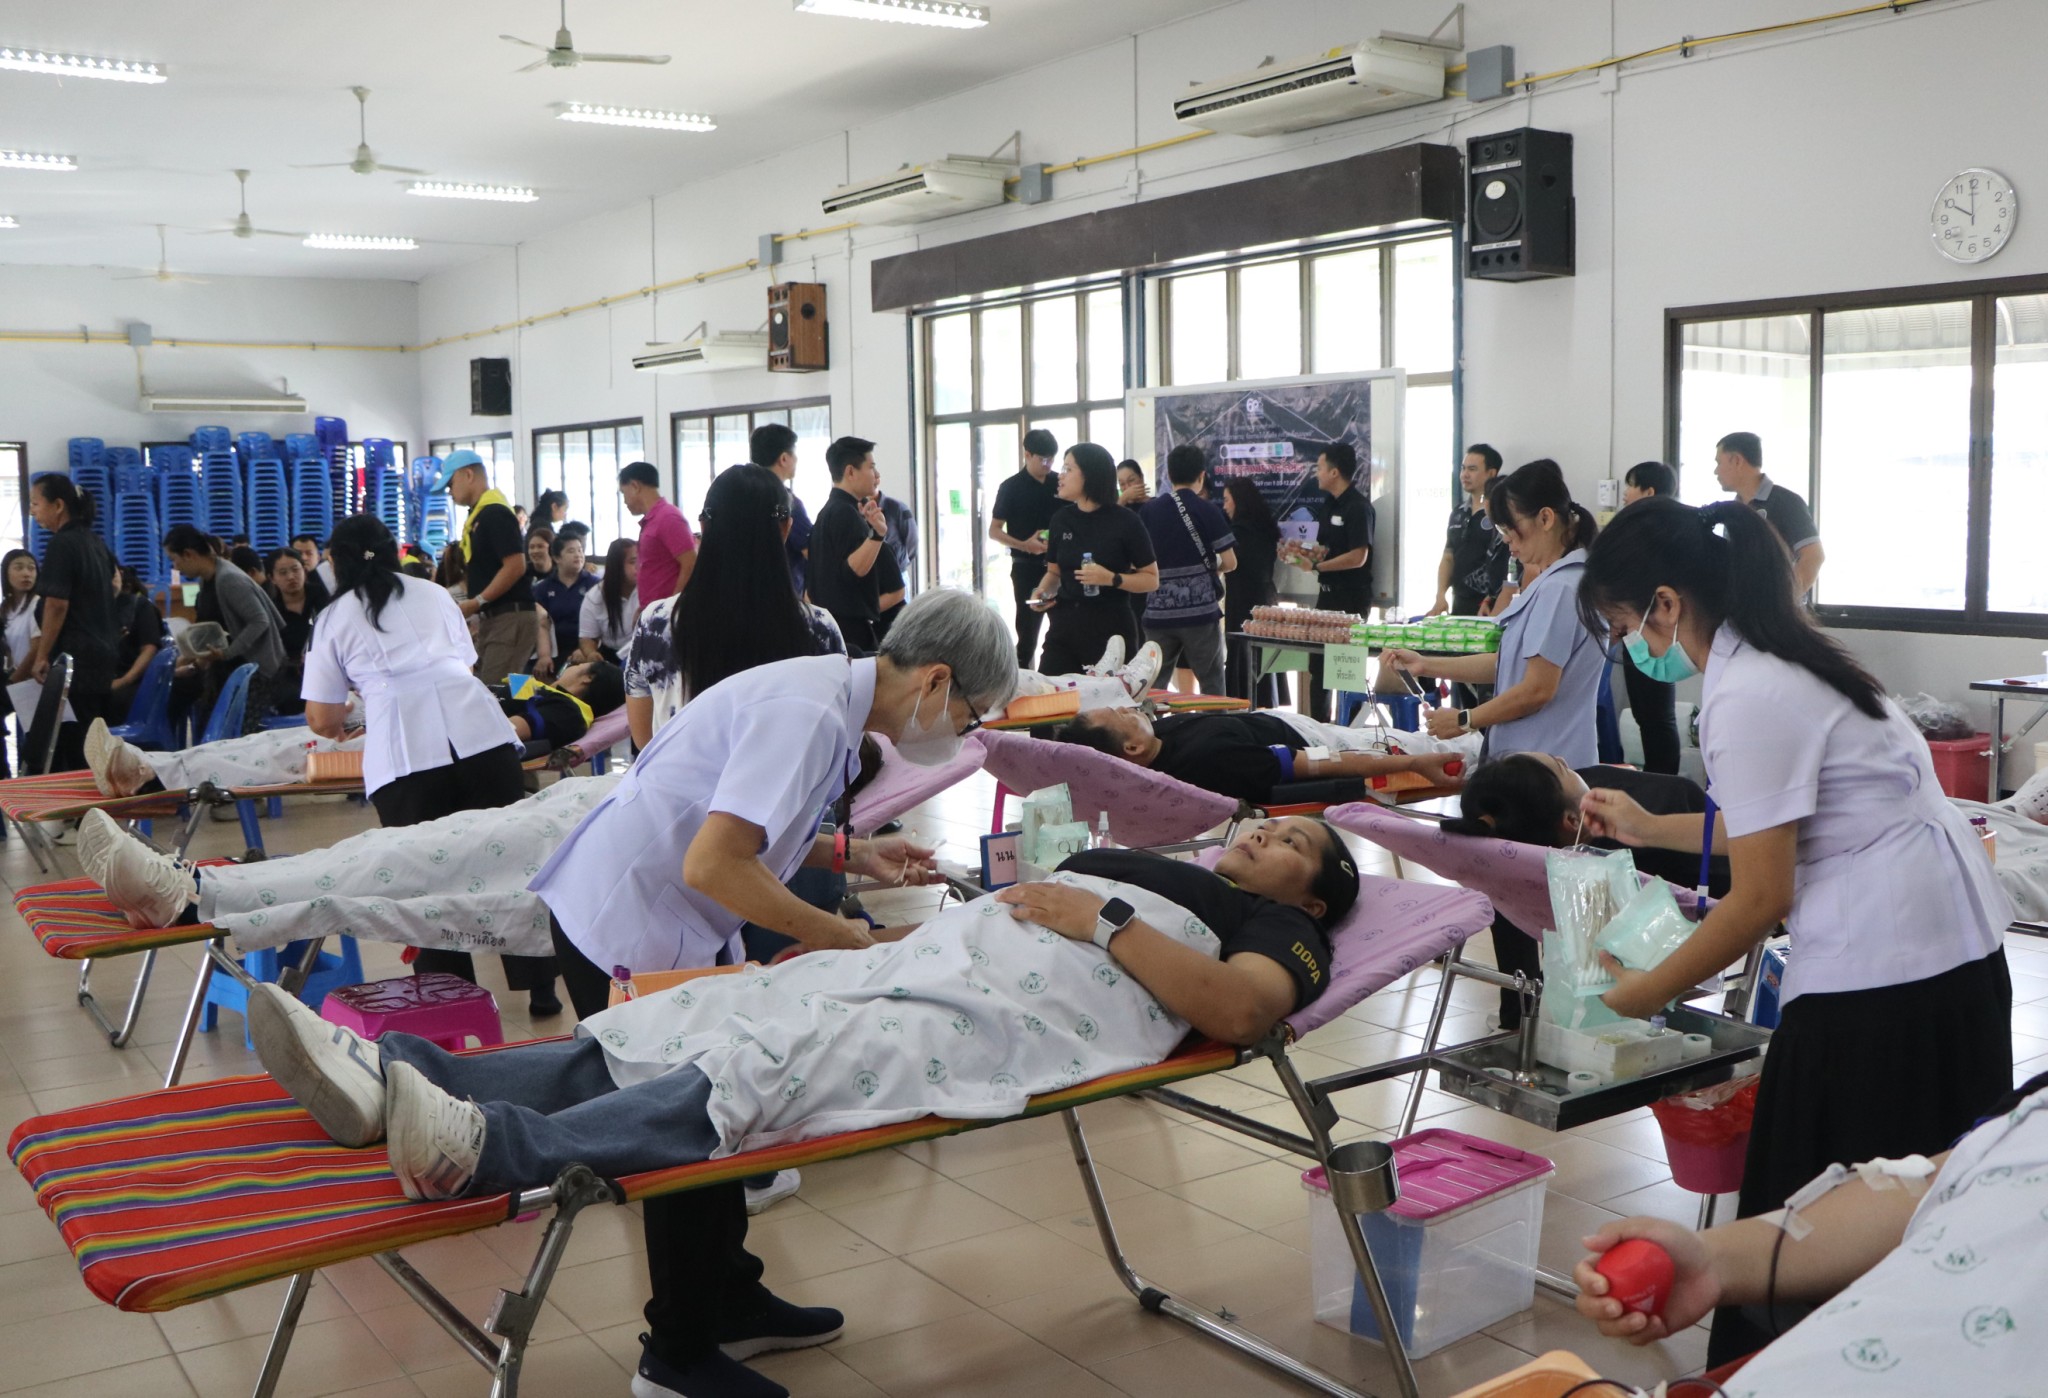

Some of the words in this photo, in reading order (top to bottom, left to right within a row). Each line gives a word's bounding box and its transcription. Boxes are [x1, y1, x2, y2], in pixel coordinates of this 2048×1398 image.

[1955, 185, 1963, 194] 11
[1995, 192, 2003, 202] 2
[1944, 199, 1955, 208] 10
[1999, 208, 2006, 218] 3
[1941, 215, 1948, 225] 9
[1994, 224, 2001, 233] 4
[1945, 230, 1952, 239] 8
[1956, 241, 1963, 250] 7
[1983, 238, 1991, 247] 5
[1968, 243, 1976, 253] 6
[1333, 653, 1360, 665] จุดรับของ
[440, 928, 507, 948] ธนาคารเลือด
[1291, 941, 1321, 984] DOPA
